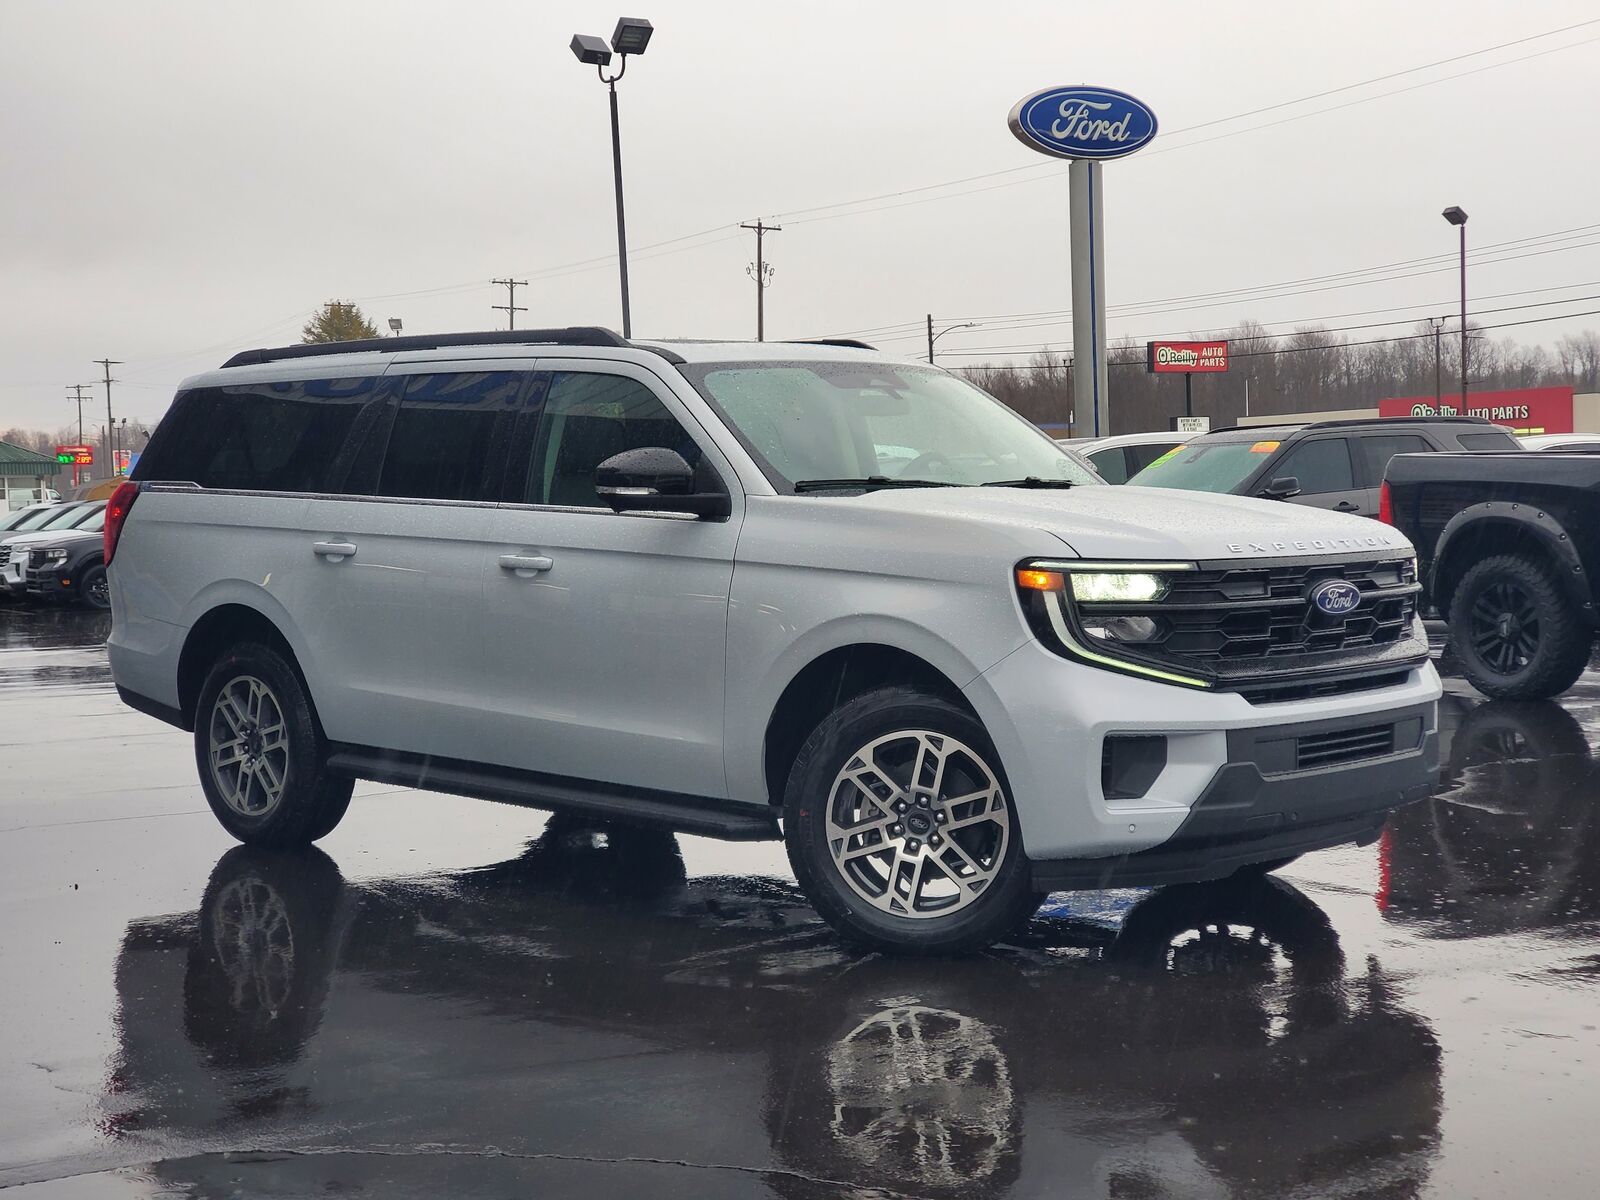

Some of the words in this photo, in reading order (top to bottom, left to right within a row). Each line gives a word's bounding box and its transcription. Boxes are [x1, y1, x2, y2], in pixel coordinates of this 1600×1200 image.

[1051, 98, 1132, 142] Ford
[1157, 347, 1198, 367] O'Reilly
[1202, 347, 1223, 357] AUTO
[1200, 358, 1225, 367] PARTS
[1462, 407, 1489, 420] UTO
[1492, 405, 1529, 420] PARTS
[1227, 536, 1392, 554] EXPEDITION
[1325, 588, 1353, 609] Ford
